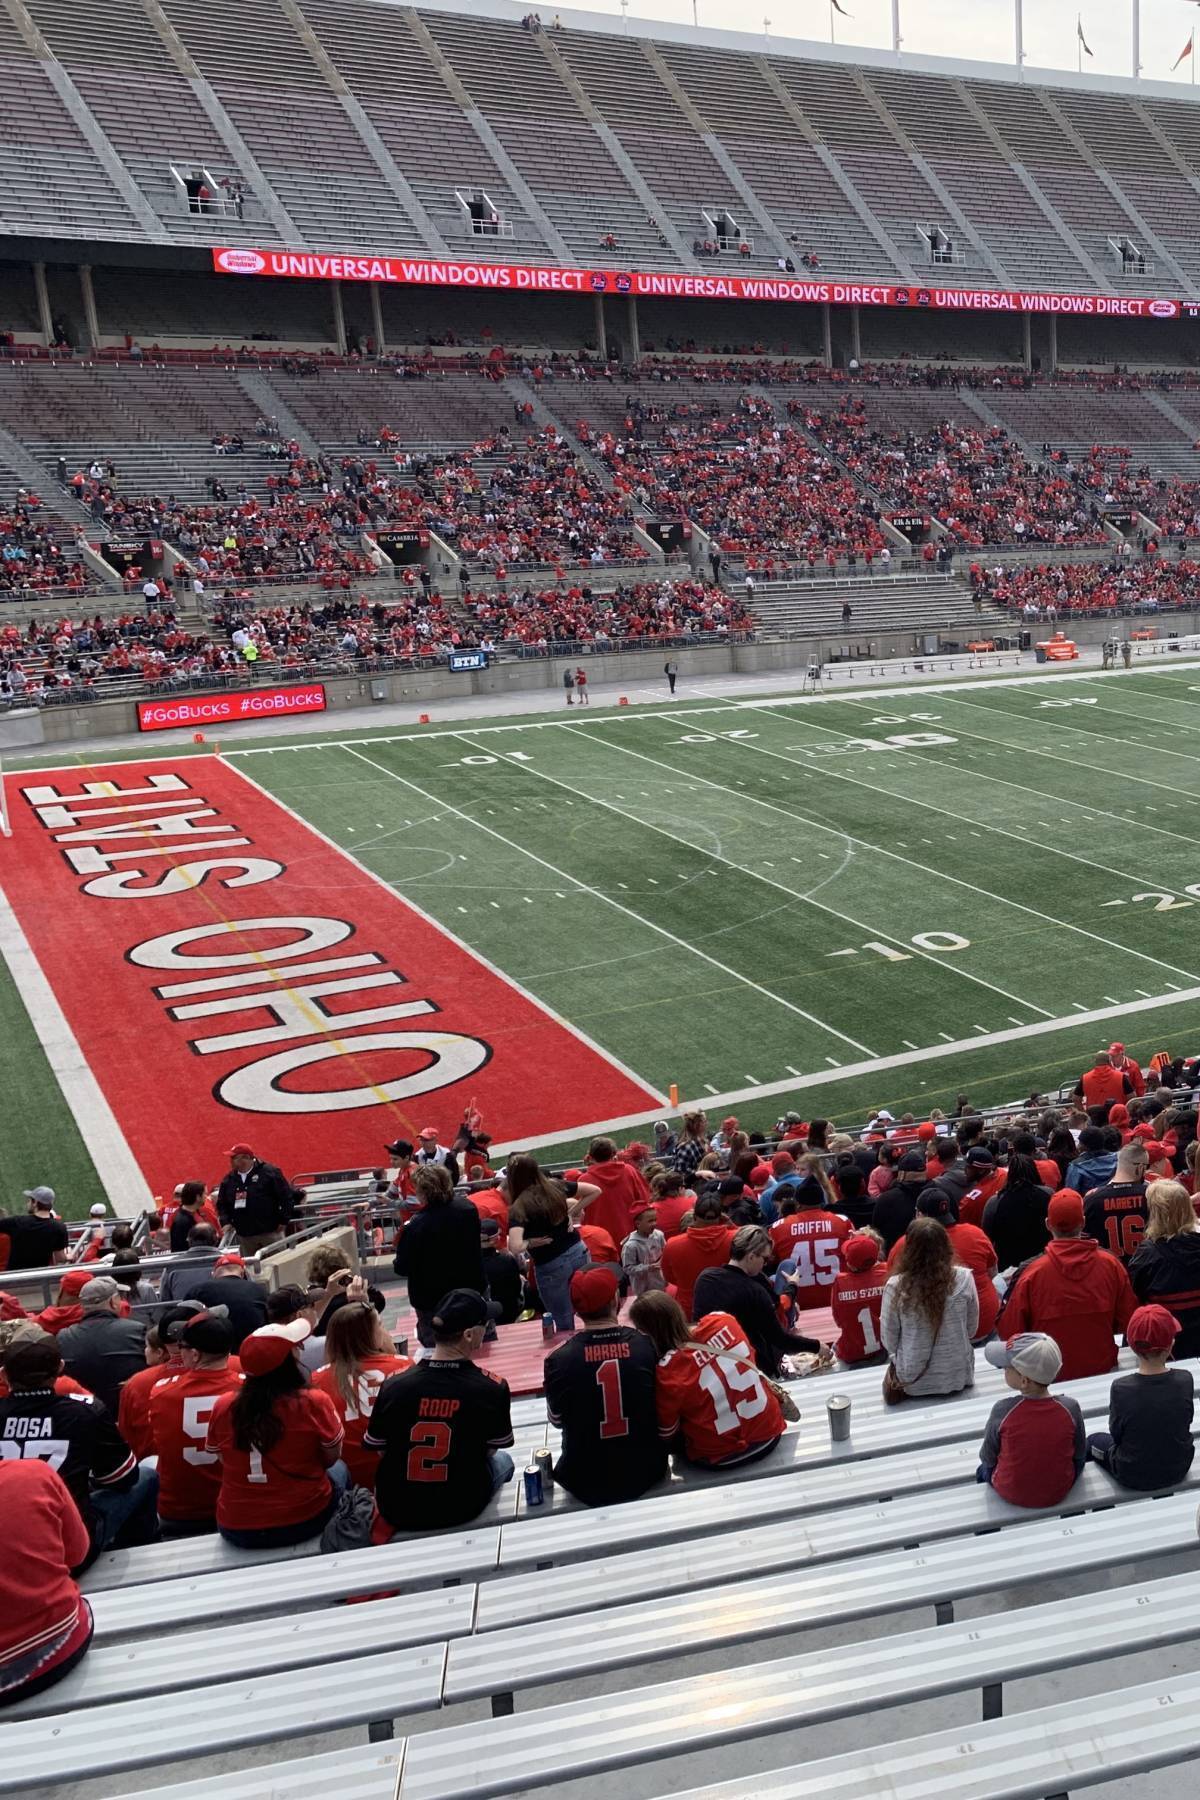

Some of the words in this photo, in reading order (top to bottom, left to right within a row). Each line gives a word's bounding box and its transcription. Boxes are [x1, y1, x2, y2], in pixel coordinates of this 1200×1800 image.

[271, 254, 397, 280] UNIVERSAL
[401, 263, 511, 287] WINDOWS
[516, 270, 584, 290] DIRECT
[638, 276, 738, 297] UNIVERSAL
[741, 282, 829, 301] WINDOWS
[834, 286, 890, 304] DIRECT
[935, 291, 1017, 309] UNIVERSAL
[1020, 295, 1094, 312] WINDOWS
[1096, 298, 1144, 314] DIRECT
[454, 656, 480, 668] BTN
[1039, 698, 1098, 707] 40
[871, 712, 942, 726] 30
[679, 729, 760, 745] 20
[459, 750, 535, 766] 10
[20, 773, 288, 899] STATE
[862, 931, 972, 962] 10
[123, 914, 495, 1114] OHIO
[1104, 1196, 1144, 1211] BARRETT
[790, 1220, 832, 1236] GRIFFIN
[1104, 1214, 1146, 1257] 16
[791, 1238, 841, 1288] 45
[584, 1343, 631, 1362] HARRIS
[596, 1358, 630, 1440] 1
[698, 1340, 768, 1436] 15
[418, 1398, 460, 1418] ROOP
[3, 1416, 52, 1438] BOSA
[182, 1396, 220, 1466] 5
[406, 1421, 452, 1482] 2
[1136, 1596, 1150, 1605] 12
[1157, 1695, 1174, 1706] 12
[958, 1742, 976, 1754] 11
